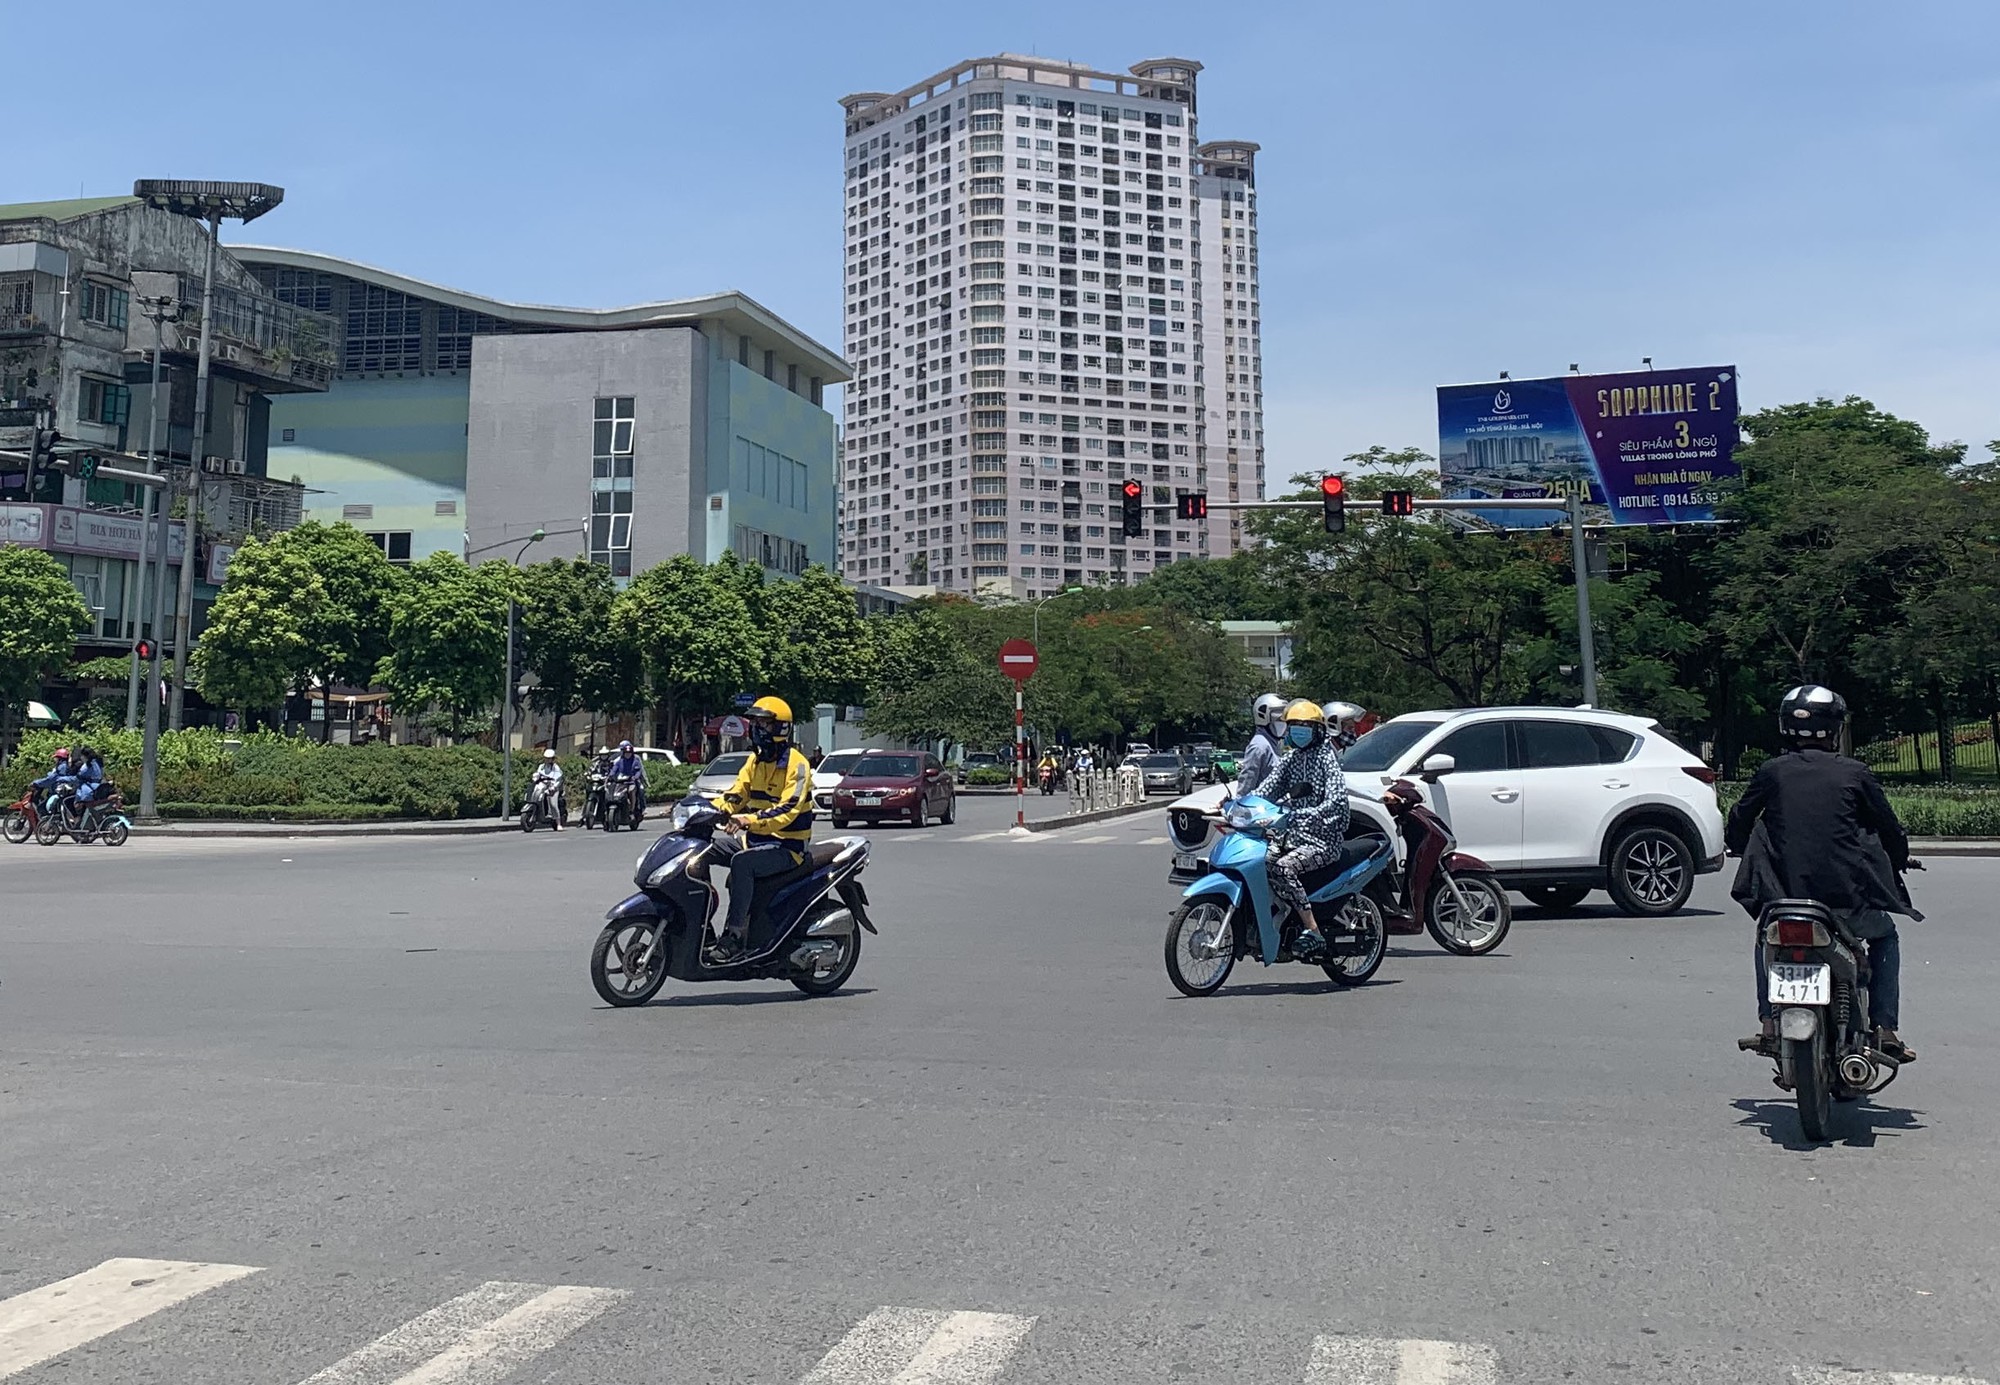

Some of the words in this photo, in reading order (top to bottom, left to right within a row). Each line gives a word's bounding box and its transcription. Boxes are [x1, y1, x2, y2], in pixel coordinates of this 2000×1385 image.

[1597, 383, 1698, 418] SAPPHIRE
[1708, 381, 1721, 411] 2
[1619, 439, 1639, 452] SIÊU
[1642, 436, 1673, 450] PHẨM
[1674, 420, 1690, 449] 3
[1692, 434, 1718, 448] NGỦ
[1620, 453, 1646, 462] VILLAS
[1646, 452, 1674, 461] TRONG
[1675, 449, 1698, 459] LÒNG
[1699, 447, 1718, 458] PHỐ
[1634, 473, 1660, 487] NHẬN
[1660, 470, 1679, 484] NHÀ
[1688, 470, 1712, 483] NGAY
[1618, 495, 1660, 508] HOTLINE:
[90, 523, 106, 536] BIA
[128, 527, 142, 541] HÀ
[1777, 984, 1820, 1001] 4171
